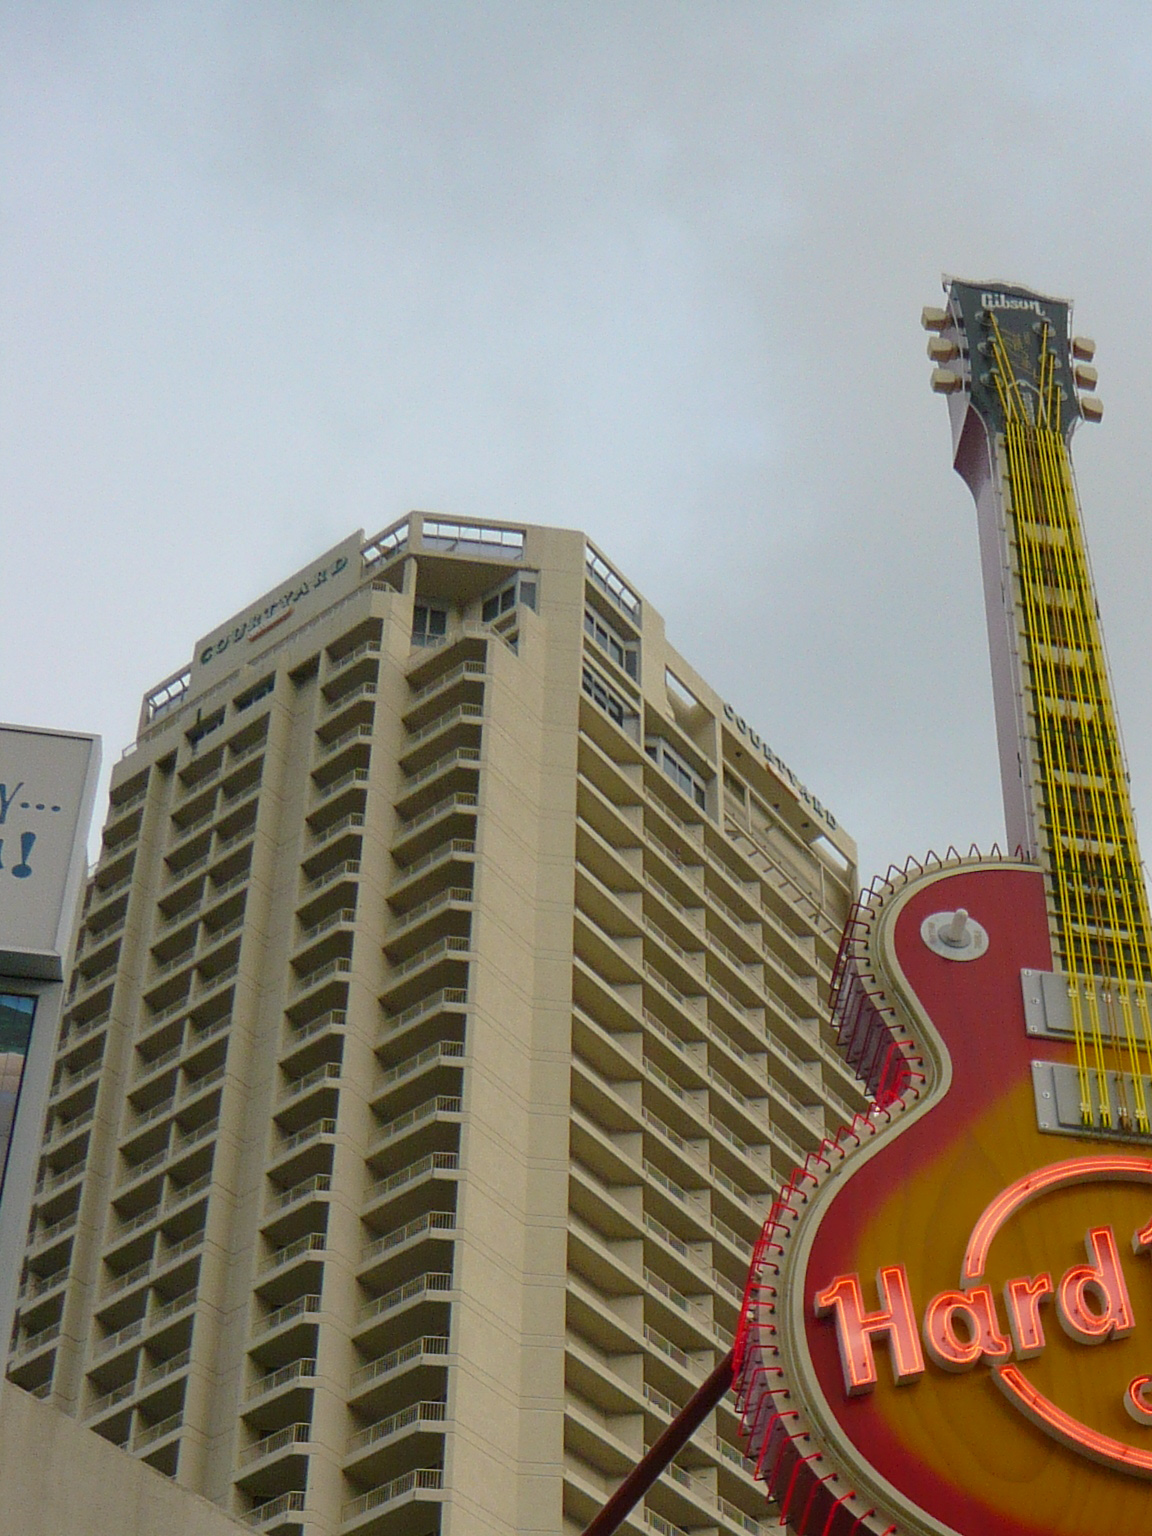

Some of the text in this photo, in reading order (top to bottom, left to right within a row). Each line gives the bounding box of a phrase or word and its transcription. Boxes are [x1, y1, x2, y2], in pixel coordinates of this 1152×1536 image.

[982, 293, 1046, 317] Gibson
[200, 556, 349, 664] COURTYARD
[814, 1225, 1136, 1396] Hard
